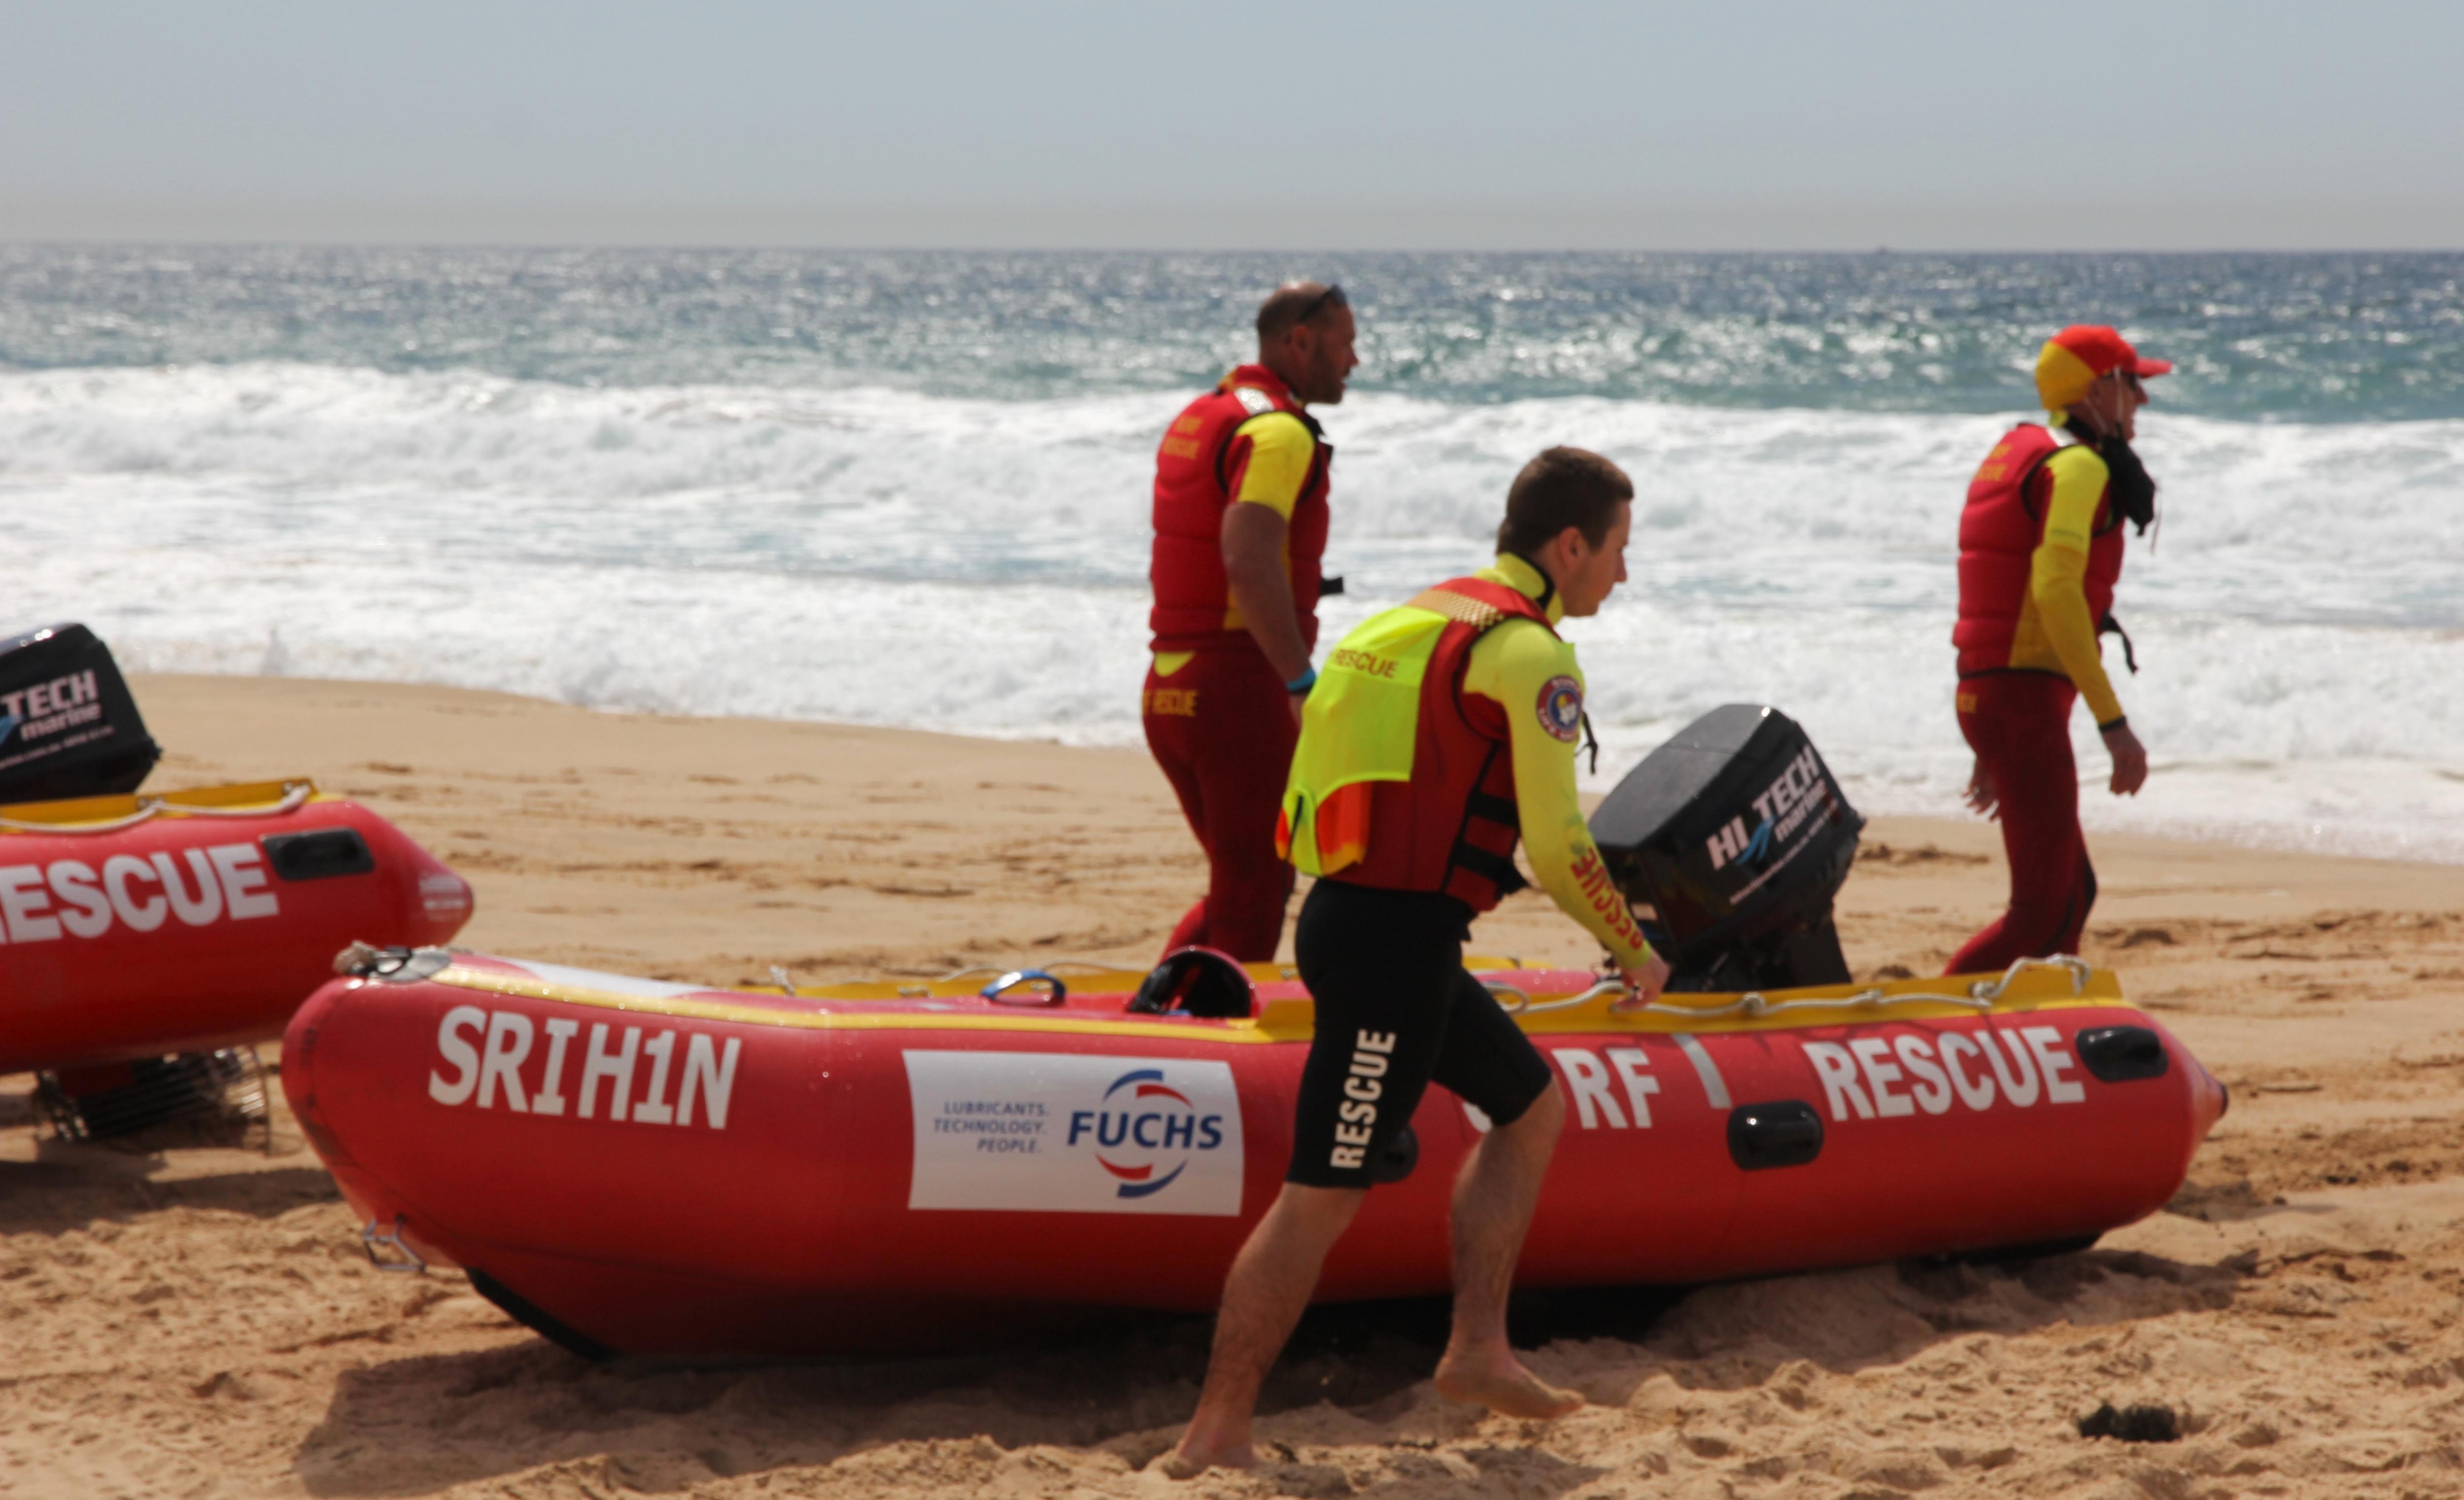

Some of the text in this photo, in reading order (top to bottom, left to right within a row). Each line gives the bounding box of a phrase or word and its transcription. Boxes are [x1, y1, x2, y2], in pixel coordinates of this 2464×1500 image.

[0, 669, 98, 725] TECH
[21, 702, 102, 741] marine
[1706, 815, 1750, 871] HI
[1751, 744, 1820, 828] TECH
[1775, 777, 1827, 842] marine
[0, 842, 279, 945] ESCUE
[1330, 1028, 1397, 1169] RESCUE
[1801, 1025, 2086, 1122] RESCUE
[933, 1117, 1048, 1135] TECHNOLOGY.
[944, 1101, 1050, 1117] LUBRICANTS.
[1066, 1111, 1223, 1151] FUCHS
[976, 1137, 1043, 1153] PEOPLE.
